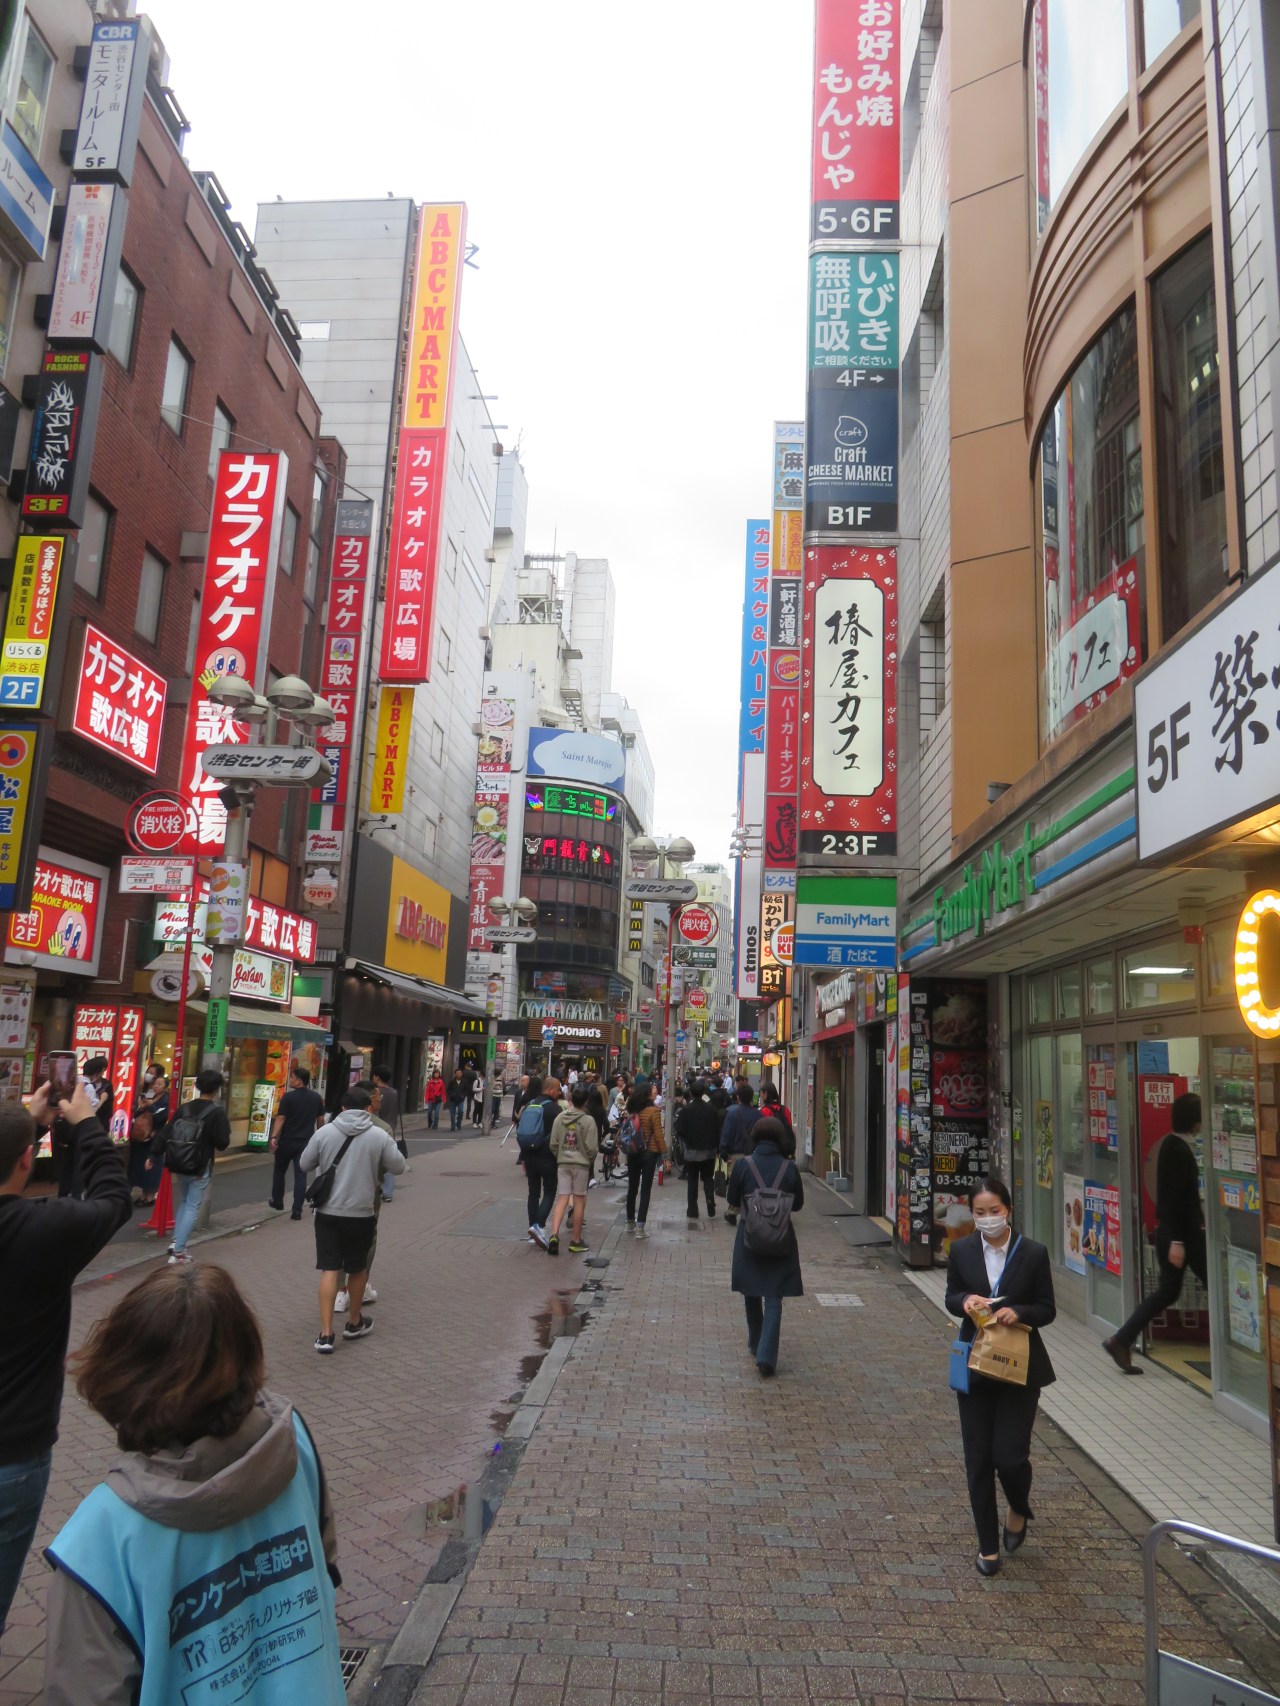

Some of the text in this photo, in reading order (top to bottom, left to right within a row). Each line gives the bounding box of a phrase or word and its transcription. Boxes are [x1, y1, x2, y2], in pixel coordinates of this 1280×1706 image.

[98, 27, 132, 39] CBR
[856, 0, 893, 126] お好み焼
[82, 45, 111, 151] モニタールーム
[818, 63, 855, 190] もんじゃ
[85, 157, 106, 168] 5F
[0, 156, 36, 214] ルーム
[814, 256, 851, 352] 無呼吸
[857, 256, 895, 351] いびき
[69, 311, 92, 325] 4F
[54, 355, 81, 363] ROCK
[814, 355, 892, 366] ご相談ください
[836, 370, 866, 386] 4F
[839, 428, 862, 436] craft
[834, 446, 867, 463] Craft
[783, 452, 804, 497] 麻雀
[808, 464, 893, 482] CHEESE MARKET
[28, 498, 63, 511] 3F
[828, 506, 871, 525] B1F
[208, 456, 270, 641] カラオケ
[393, 447, 432, 661] カラオケ歌広場
[33, 545, 56, 635] 全身もみほぐし
[321, 538, 363, 743] カラオケ 歌広場
[9, 646, 42, 656] りらくる
[6, 661, 40, 673] 渋谷店
[85, 640, 163, 718] カラオケ
[825, 603, 873, 771] 椿屋カフェ
[5, 681, 35, 700] 2F
[1209, 621, 1280, 775] 築
[89, 691, 149, 759] 歌広場
[779, 696, 795, 788] バーガーキング
[1147, 701, 1191, 794] 5F
[208, 753, 313, 769] 渋谷センター街
[562, 751, 584, 762] Saint
[140, 815, 182, 834] 消火栓
[34, 866, 95, 904] ラオケ歌広場
[628, 884, 694, 894] 渋谷センター街
[934, 822, 1035, 947] FamilyMart
[33, 891, 84, 912] ARAOKE ROOM
[158, 912, 189, 923] Miam
[470, 881, 488, 945] 青龍門
[816, 912, 890, 928] FamilyMart
[15, 926, 38, 941] 2F
[682, 918, 709, 931] 消火栓
[744, 926, 757, 983] atmos
[827, 946, 877, 963] 酒 たばこ
[77, 1009, 115, 1023] カラオケ
[76, 1026, 113, 1041] 歌広場
[114, 1010, 138, 1105] カラオケ
[1148, 1083, 1170, 1094] 銀行
[1149, 1094, 1171, 1104] ATM
[949, 1134, 970, 1147] NERO
[936, 1159, 955, 1171] NERO
[170, 1538, 309, 1635] アンケート実施中
